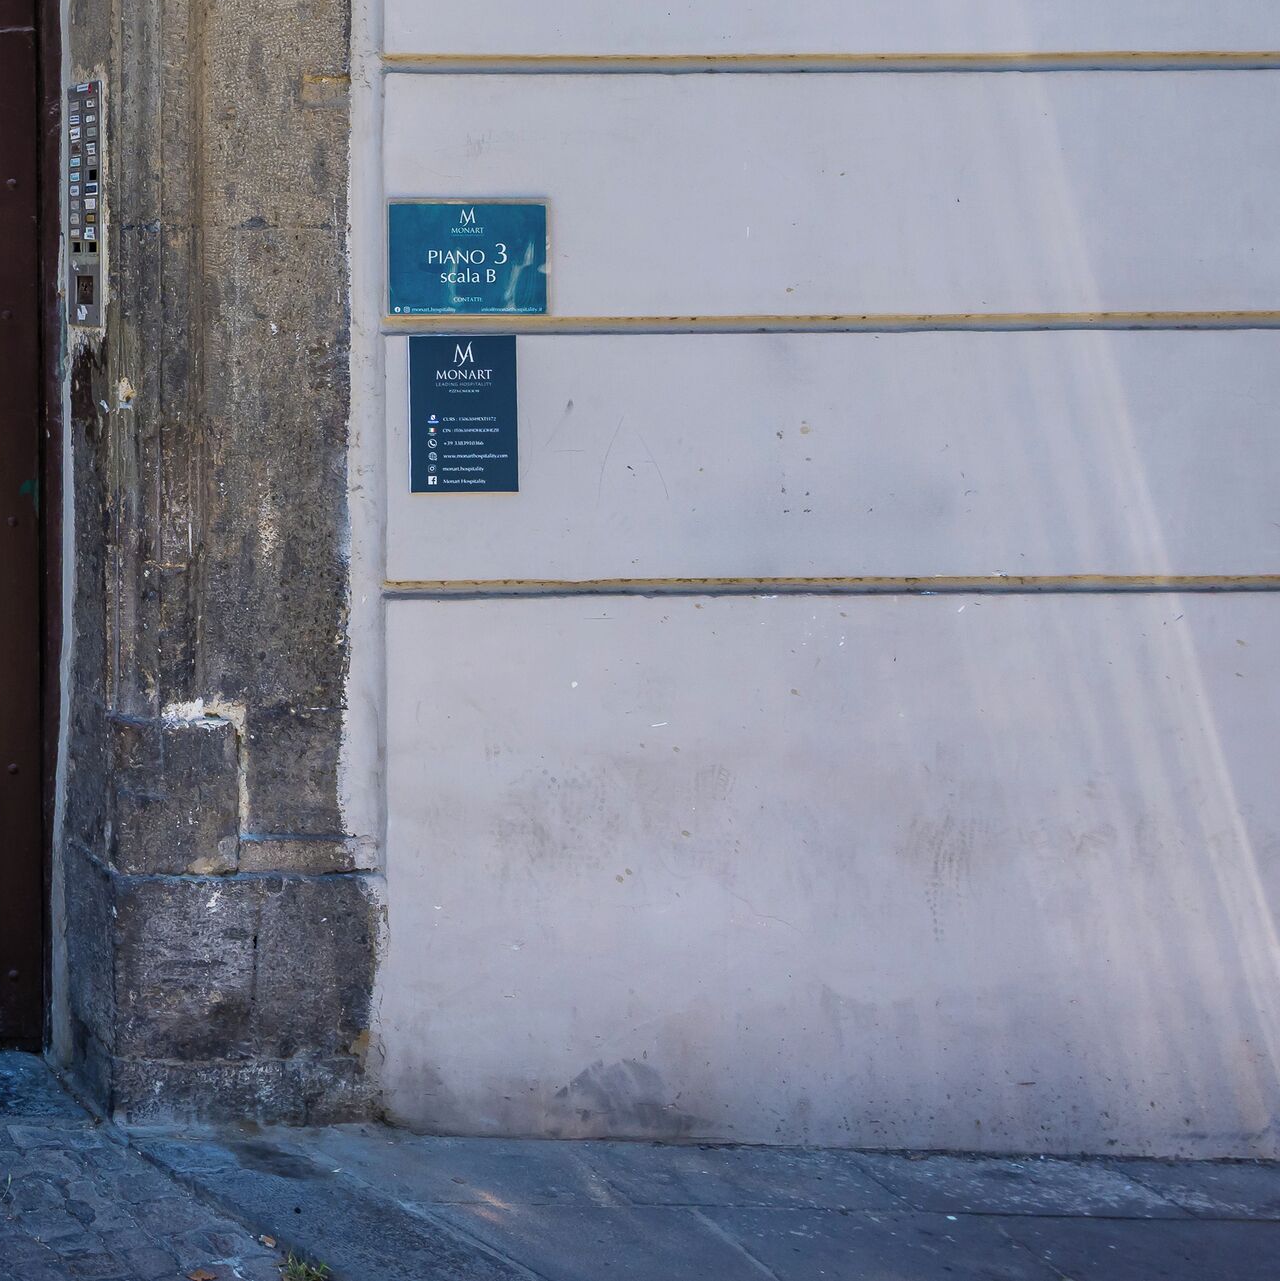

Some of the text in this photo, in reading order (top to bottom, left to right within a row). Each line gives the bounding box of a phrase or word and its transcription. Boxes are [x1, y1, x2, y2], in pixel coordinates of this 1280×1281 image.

[428, 243, 508, 265] PIANO 3
[440, 268, 496, 284] scala B
[435, 369, 493, 380] MONART
